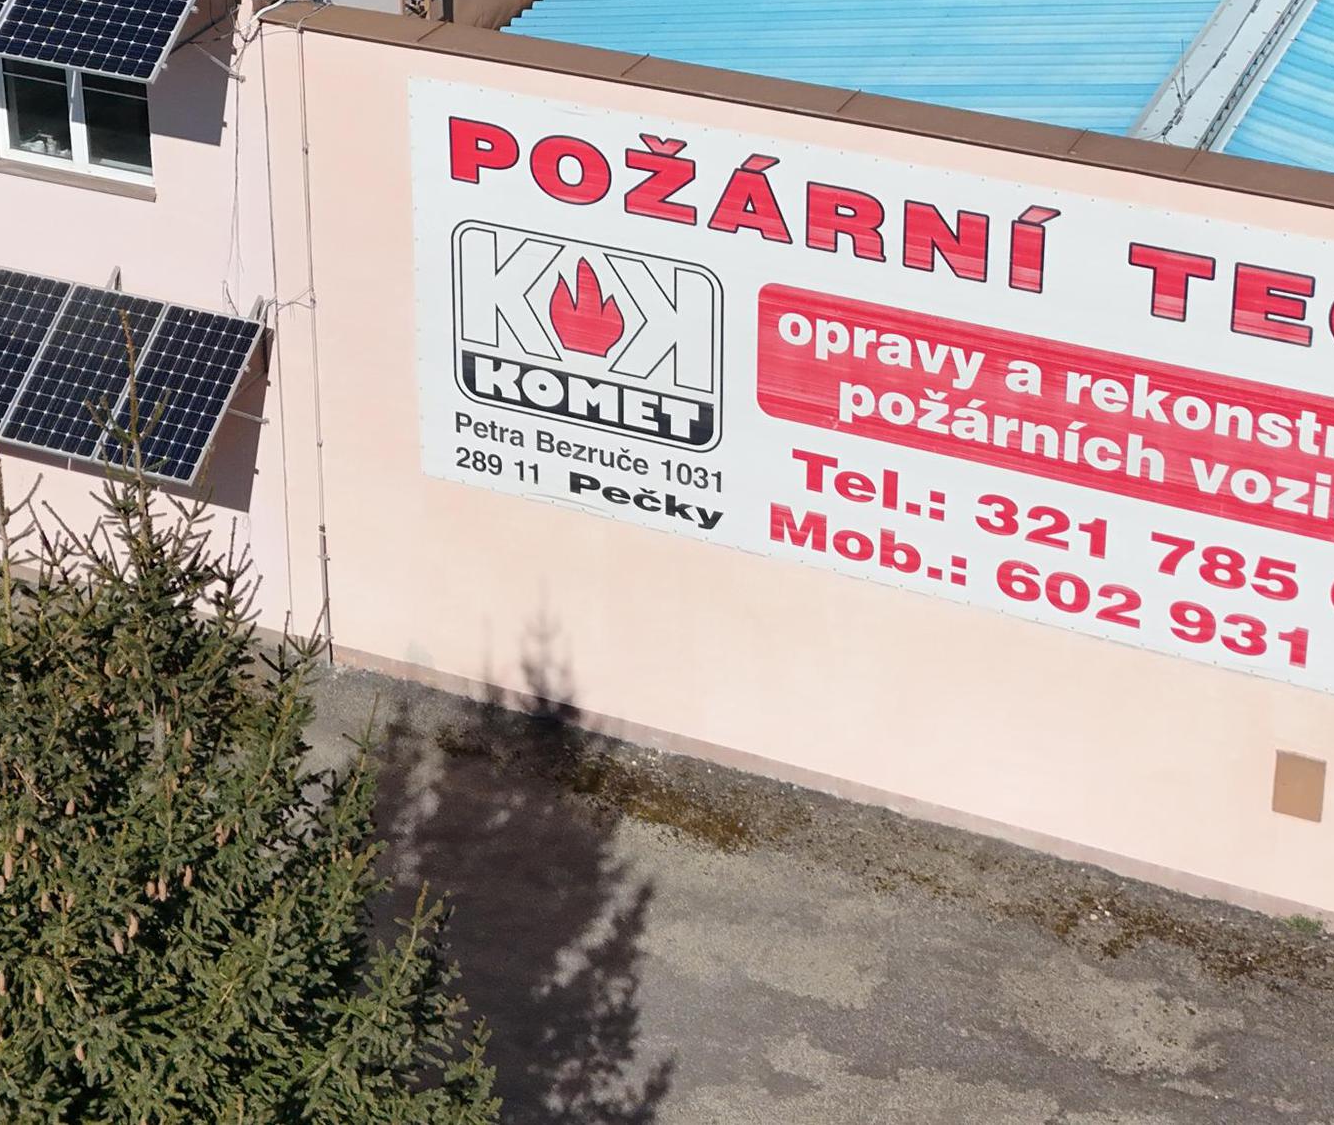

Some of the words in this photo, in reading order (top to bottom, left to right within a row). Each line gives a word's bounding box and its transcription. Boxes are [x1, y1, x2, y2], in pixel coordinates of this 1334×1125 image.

[448, 116, 1062, 295] POŽÁRNÍ
[474, 355, 701, 440] KOMET
[778, 312, 986, 391] opravy
[1005, 359, 1043, 397] a
[455, 411, 525, 448] Petra
[536, 429, 650, 476] Bezruče
[660, 458, 723, 493] 1031
[839, 380, 1165, 484] požárních
[455, 446, 504, 476] 289
[514, 460, 540, 485] 11
[569, 470, 725, 530] Pečky
[791, 447, 946, 522] Tel.:
[974, 493, 1108, 560] 321
[1149, 531, 1300, 602] 785
[769, 501, 967, 587] Mob.:
[996, 559, 1143, 630] 602
[1168, 600, 1310, 670] 931
